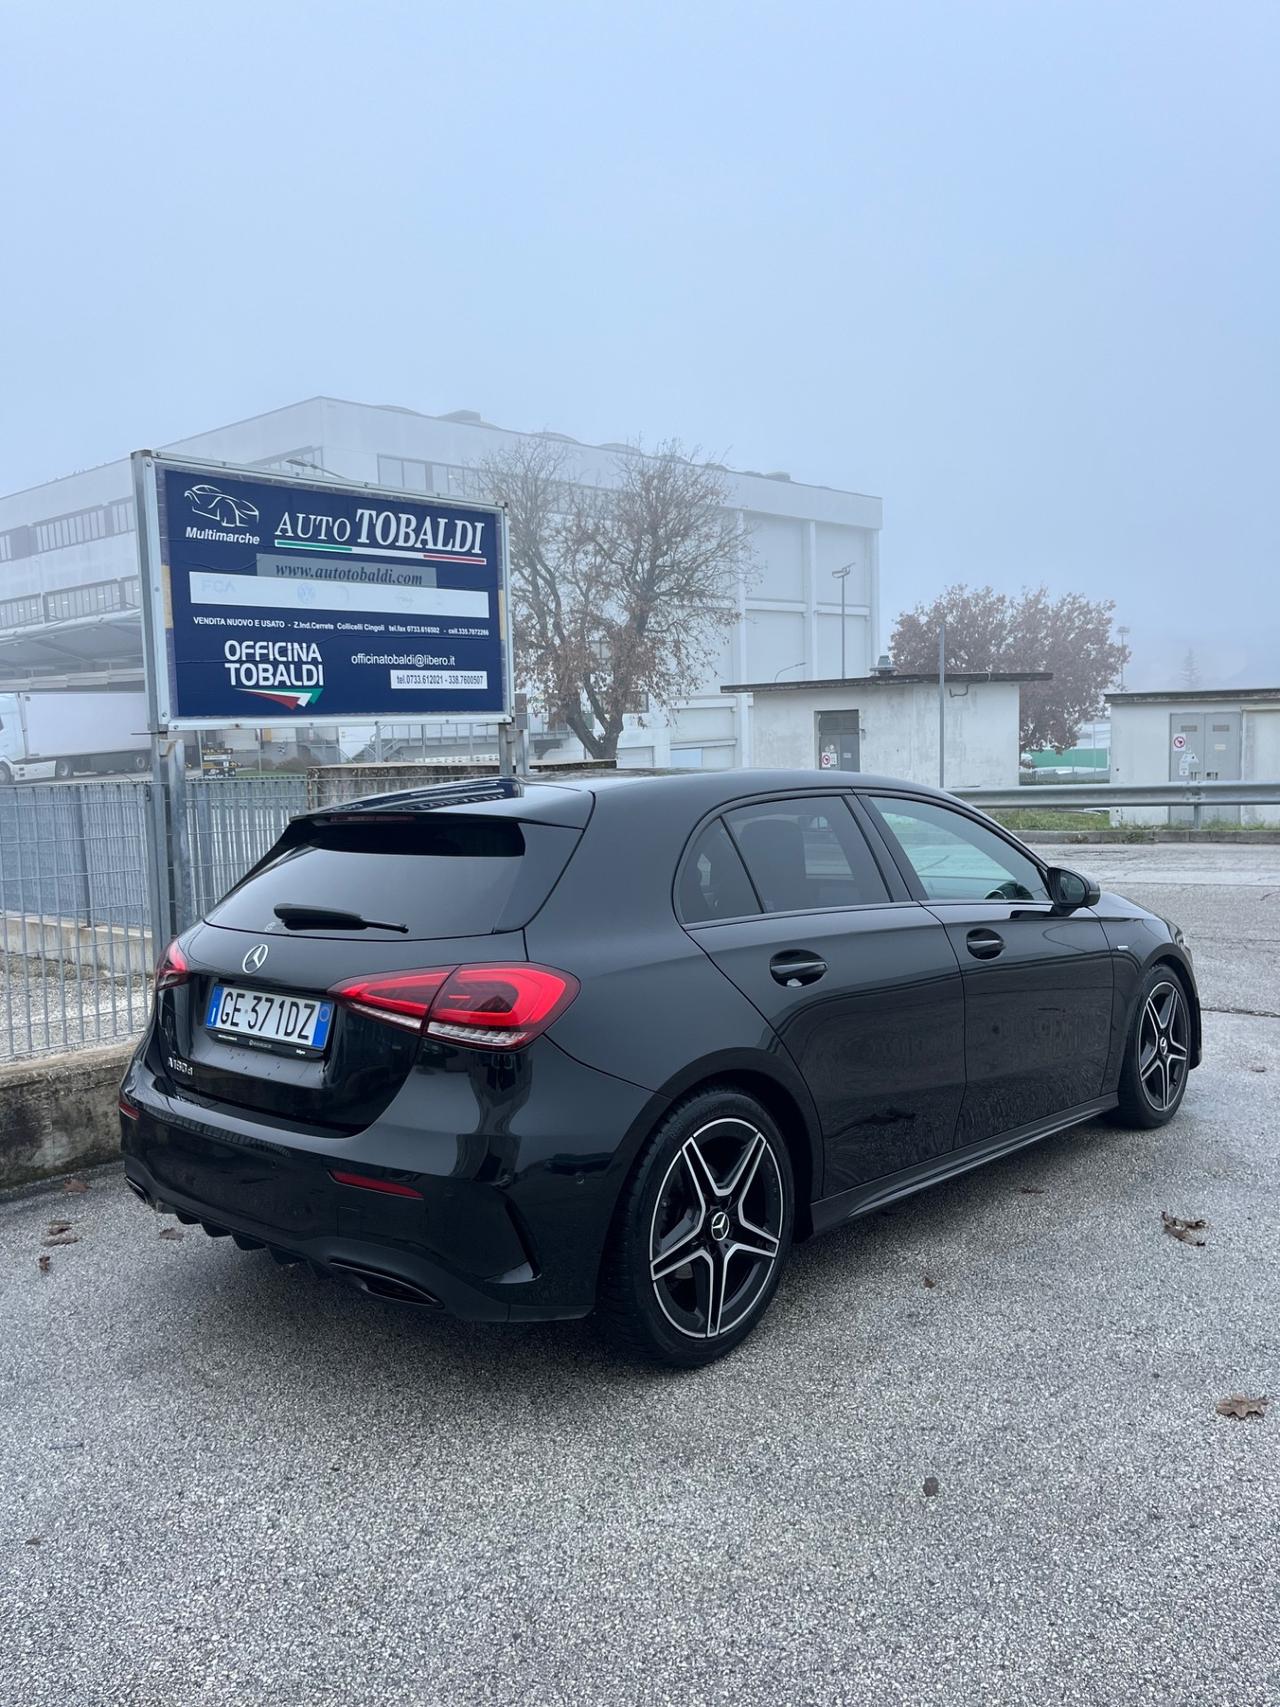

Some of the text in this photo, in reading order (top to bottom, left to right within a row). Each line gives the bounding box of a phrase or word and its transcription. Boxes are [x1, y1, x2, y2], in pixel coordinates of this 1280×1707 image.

[186, 526, 260, 545] Multimarche
[275, 509, 485, 554] AUTO TOBALDI
[275, 562, 423, 586] www.autotobaldi.com
[193, 616, 226, 626] VENDITA
[226, 619, 254, 628] NUOVO
[255, 619, 261, 627] E
[261, 620, 285, 629] USATO
[364, 623, 385, 633] Cingoli
[224, 640, 322, 662] OFFICINA
[351, 652, 456, 668] officinatobaldi@libero.it
[224, 663, 324, 686] TOBALDI
[220, 991, 316, 1041] GE 371DZ
